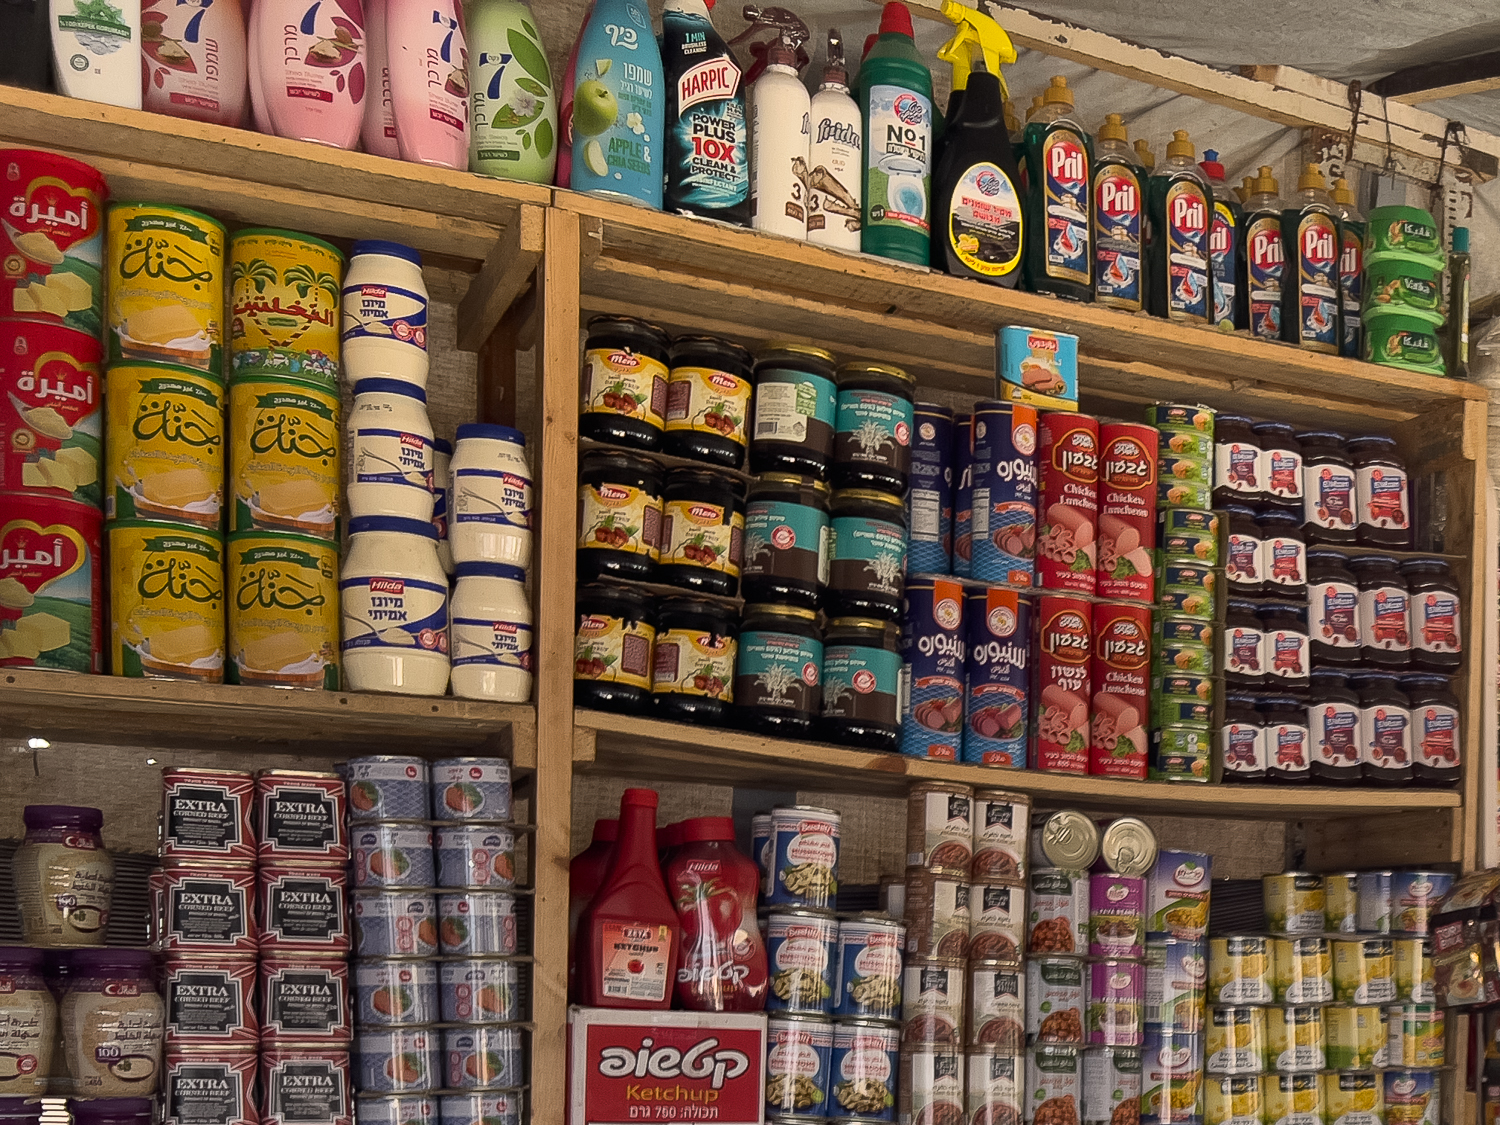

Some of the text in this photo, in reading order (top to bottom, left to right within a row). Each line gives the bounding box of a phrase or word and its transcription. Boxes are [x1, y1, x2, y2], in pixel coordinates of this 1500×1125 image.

[682, 67, 729, 101] HARPIC
[692, 113, 736, 131] POWER
[692, 124, 735, 143] PLUS
[608, 136, 642, 153] APPLE
[691, 136, 736, 164] 10X
[692, 157, 725, 171] CLEAN
[1052, 147, 1084, 181] Pril
[1102, 181, 1135, 212] Pril
[9, 196, 88, 230] أميرة
[1175, 198, 1204, 229] Pril
[1210, 227, 1227, 250] ril
[1305, 230, 1333, 259] Pril
[1340, 248, 1356, 273] ril
[17, 372, 93, 405] أميرة
[0, 539, 62, 569] أمير
[368, 609, 407, 622] אמיתי
[175, 799, 227, 813] EXTRA
[275, 801, 327, 815] EXTRA
[180, 892, 233, 905] EXTRA
[281, 891, 332, 903] EXTRA
[176, 985, 228, 997] EXTRA
[281, 984, 332, 996] EXTRA
[599, 1037, 750, 1090] קטשופ
[176, 1079, 228, 1091] EXTRA
[283, 1075, 333, 1087] EXTRA
[626, 1084, 719, 1104] Ketchup
